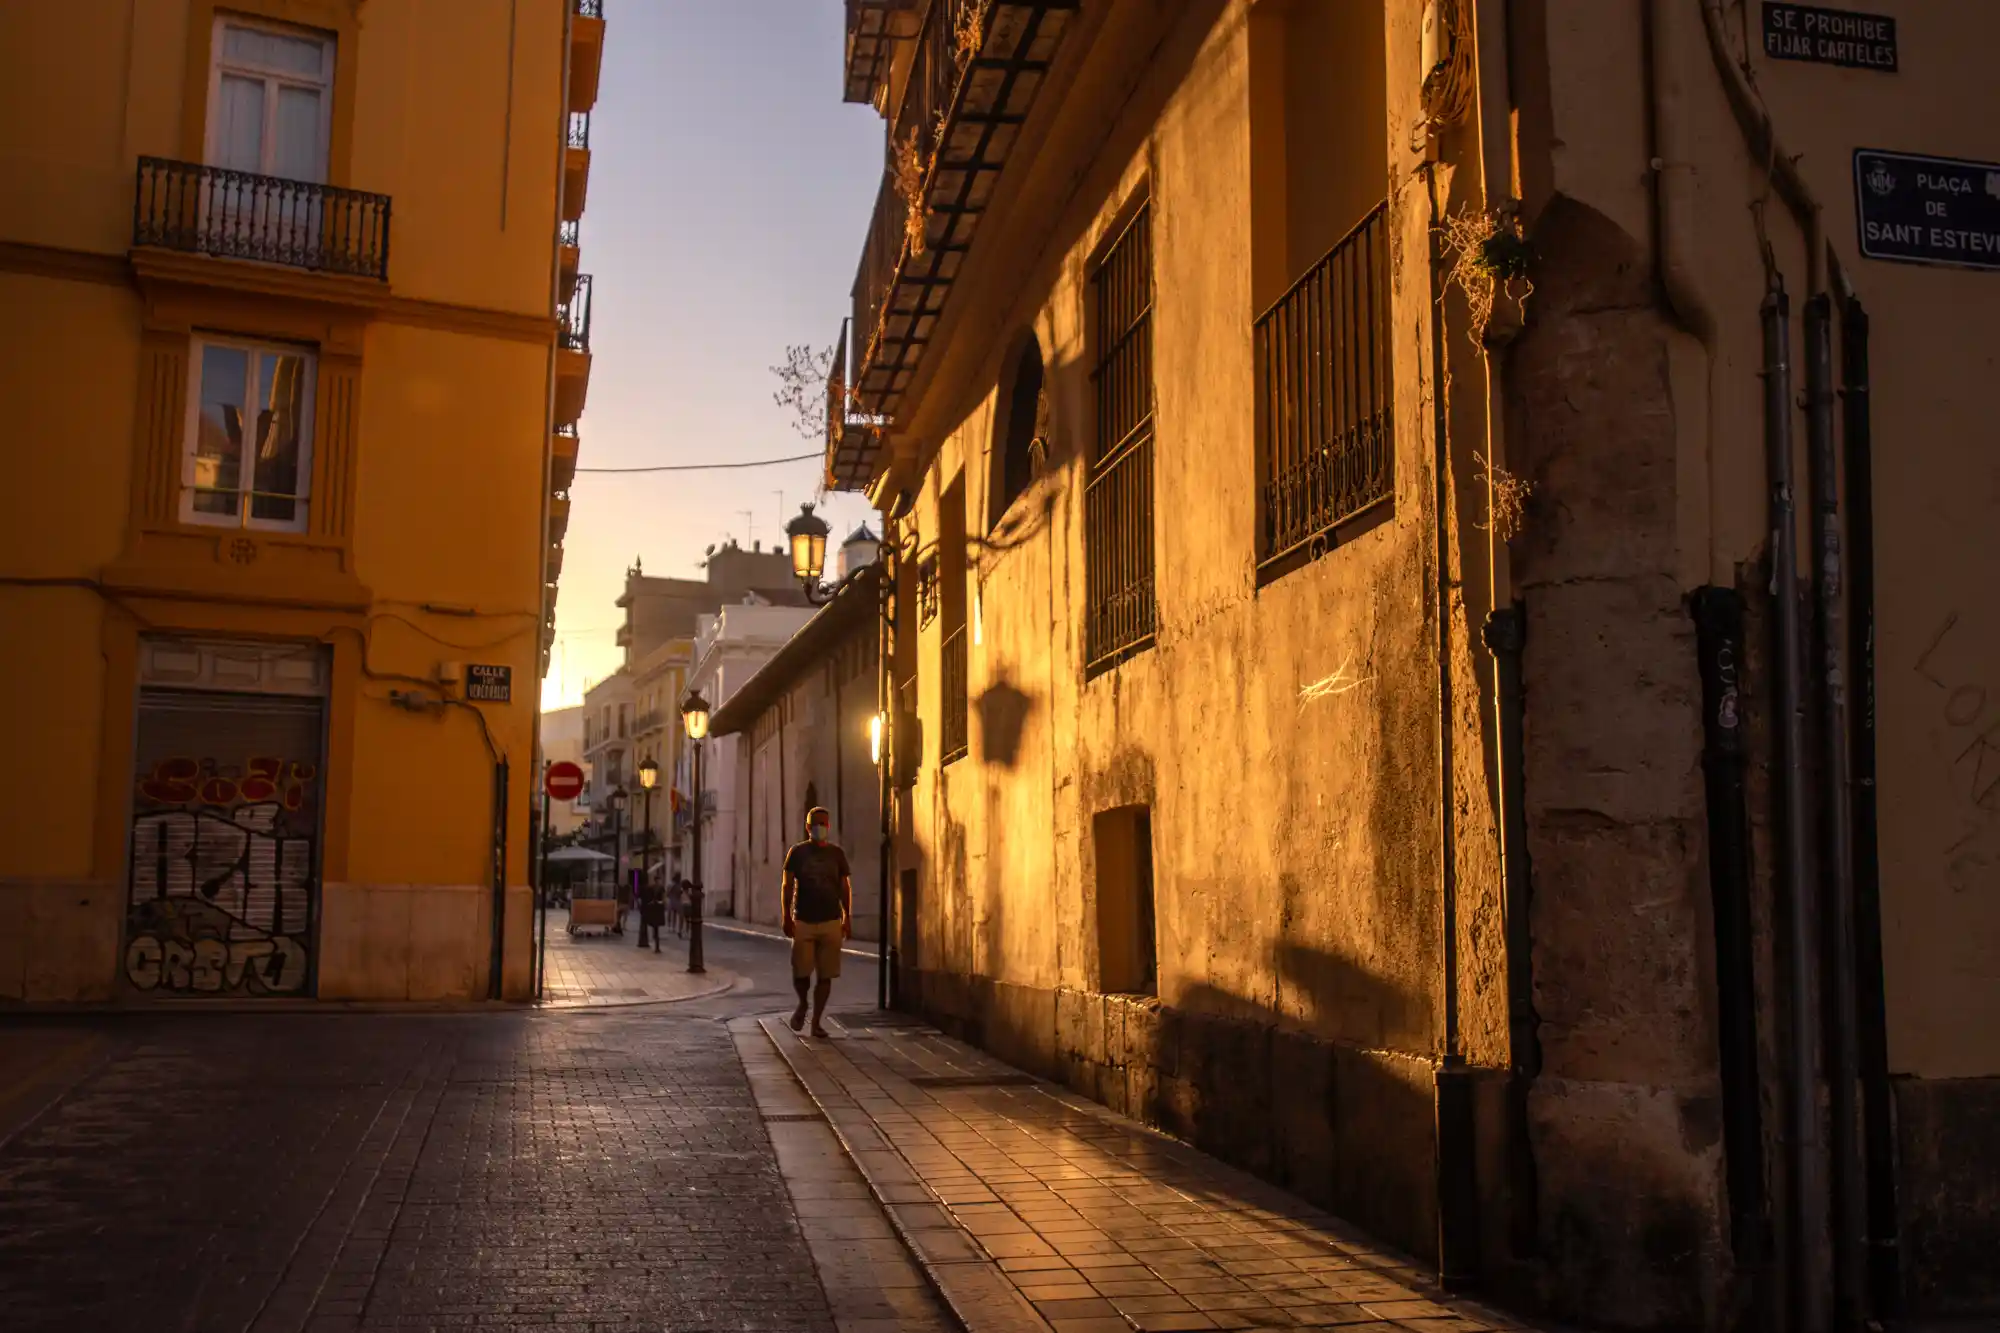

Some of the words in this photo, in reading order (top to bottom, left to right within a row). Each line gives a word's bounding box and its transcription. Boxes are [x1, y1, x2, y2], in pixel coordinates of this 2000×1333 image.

[1772, 9, 1798, 30] SE
[1804, 12, 1889, 41] PROHIBE
[1766, 32, 1812, 57] FIJAR
[1817, 37, 1895, 66] CARTELES
[1916, 173, 1973, 196] PLAÇA
[1925, 200, 1947, 217] DE
[1867, 221, 1923, 245] SANT
[472, 666, 506, 677] CALLE
